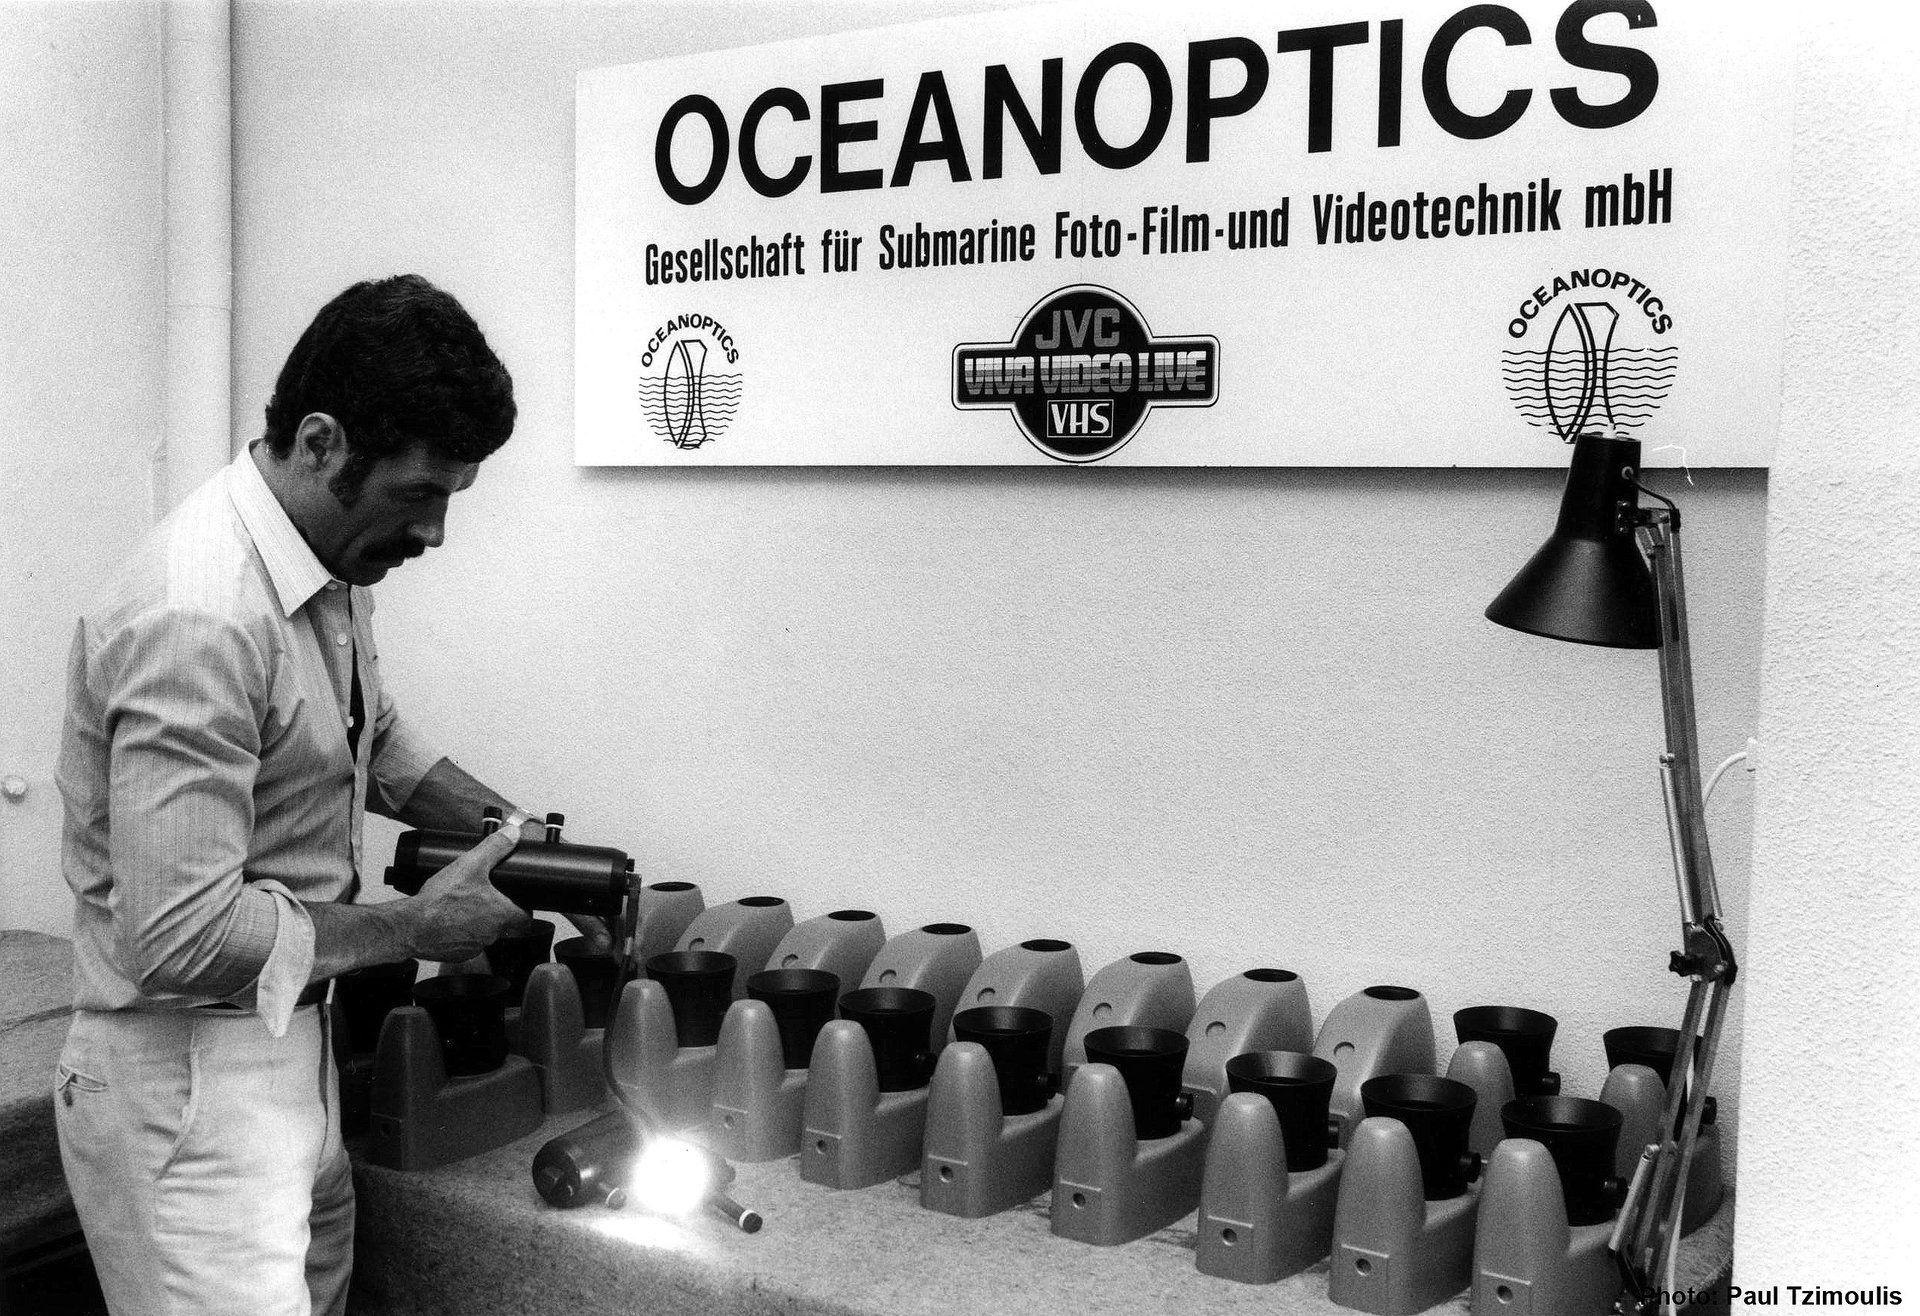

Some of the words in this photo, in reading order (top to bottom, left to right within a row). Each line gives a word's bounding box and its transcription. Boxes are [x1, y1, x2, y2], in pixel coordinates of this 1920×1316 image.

[655, 0, 1659, 205] OCEANOPTICS
[645, 233, 805, 286] Gesellschaft
[821, 229, 862, 274] für
[879, 219, 1036, 270] Submarine
[1312, 178, 1562, 245] Videotechnik
[1585, 167, 1673, 229] mbH
[1035, 308, 1121, 350] JVC
[1508, 268, 1673, 339] OCEANOPTICS
[641, 313, 739, 368] OCEANOPTICS
[964, 355, 1035, 395] VIVA
[1040, 352, 1133, 394] VIDEO
[1138, 350, 1207, 392] LIVE
[1050, 403, 1111, 435] VHS
